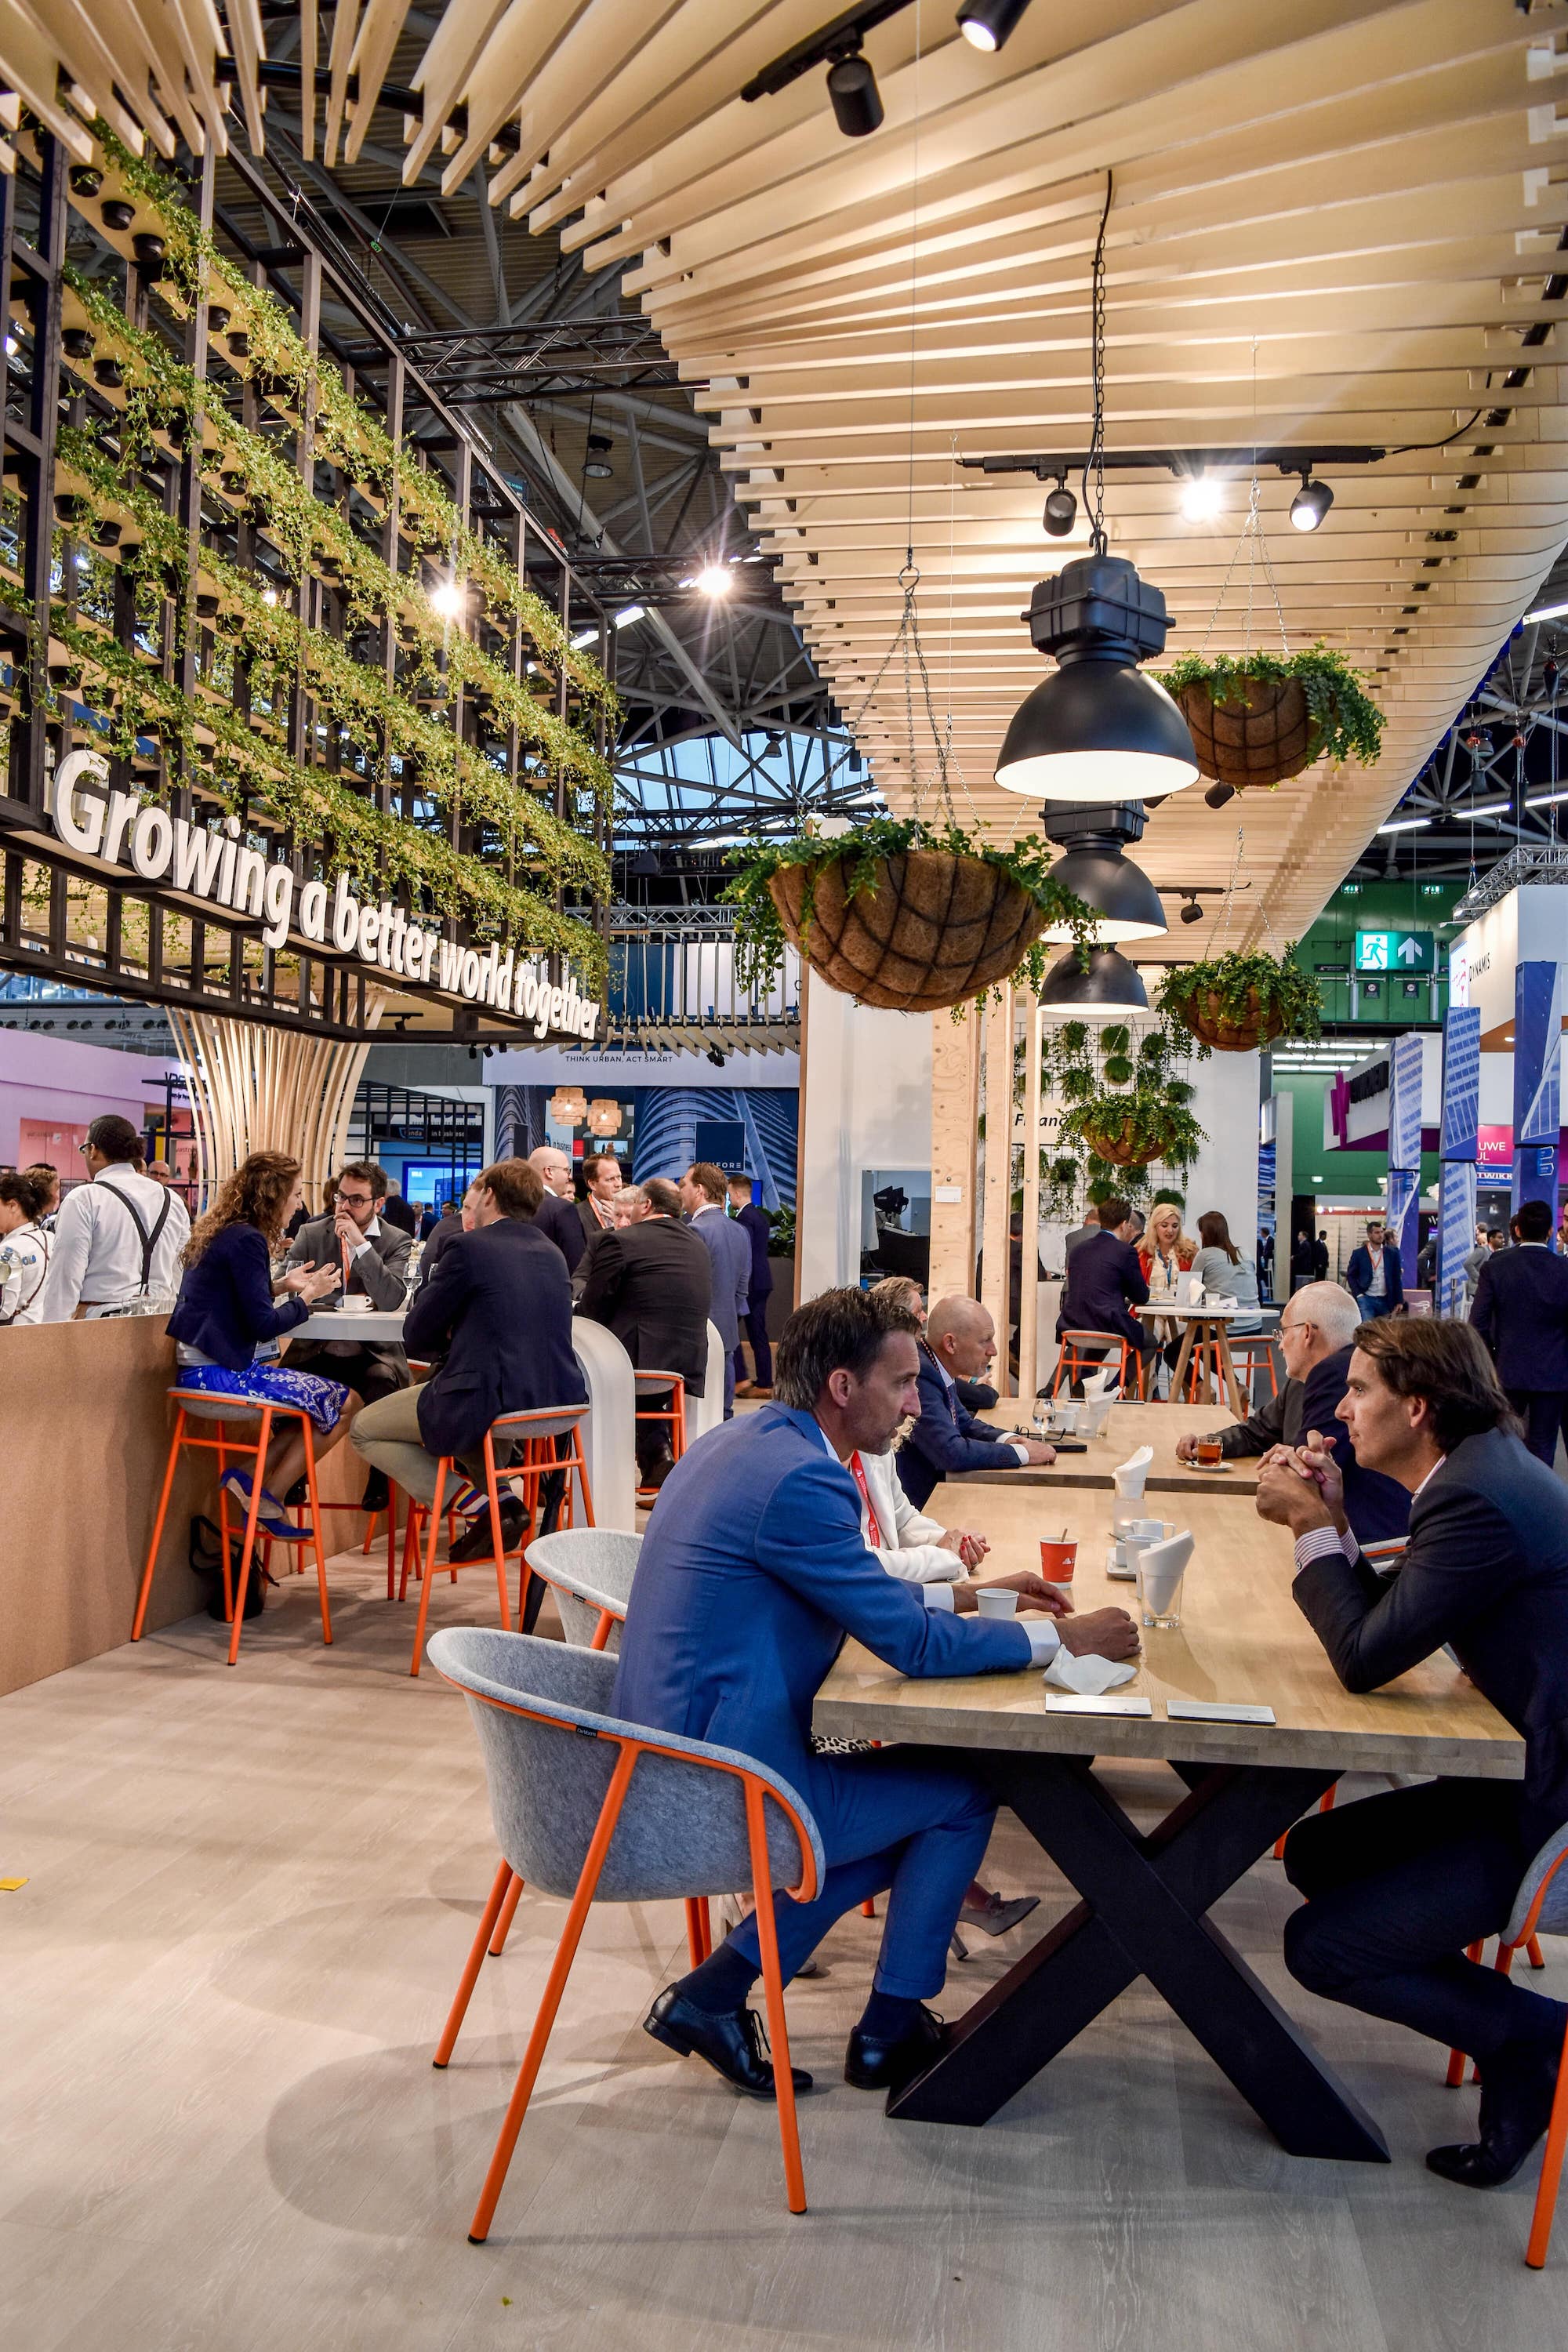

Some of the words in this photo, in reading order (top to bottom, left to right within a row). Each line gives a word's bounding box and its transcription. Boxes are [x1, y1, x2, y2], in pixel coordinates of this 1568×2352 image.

[53, 750, 294, 949] Growing
[299, 880, 328, 942] a
[334, 871, 438, 982] better
[439, 938, 514, 1011] world
[514, 963, 600, 1040] together
[1468, 952, 1490, 982] DYNAMIS
[1479, 1142, 1506, 1151] UWE
